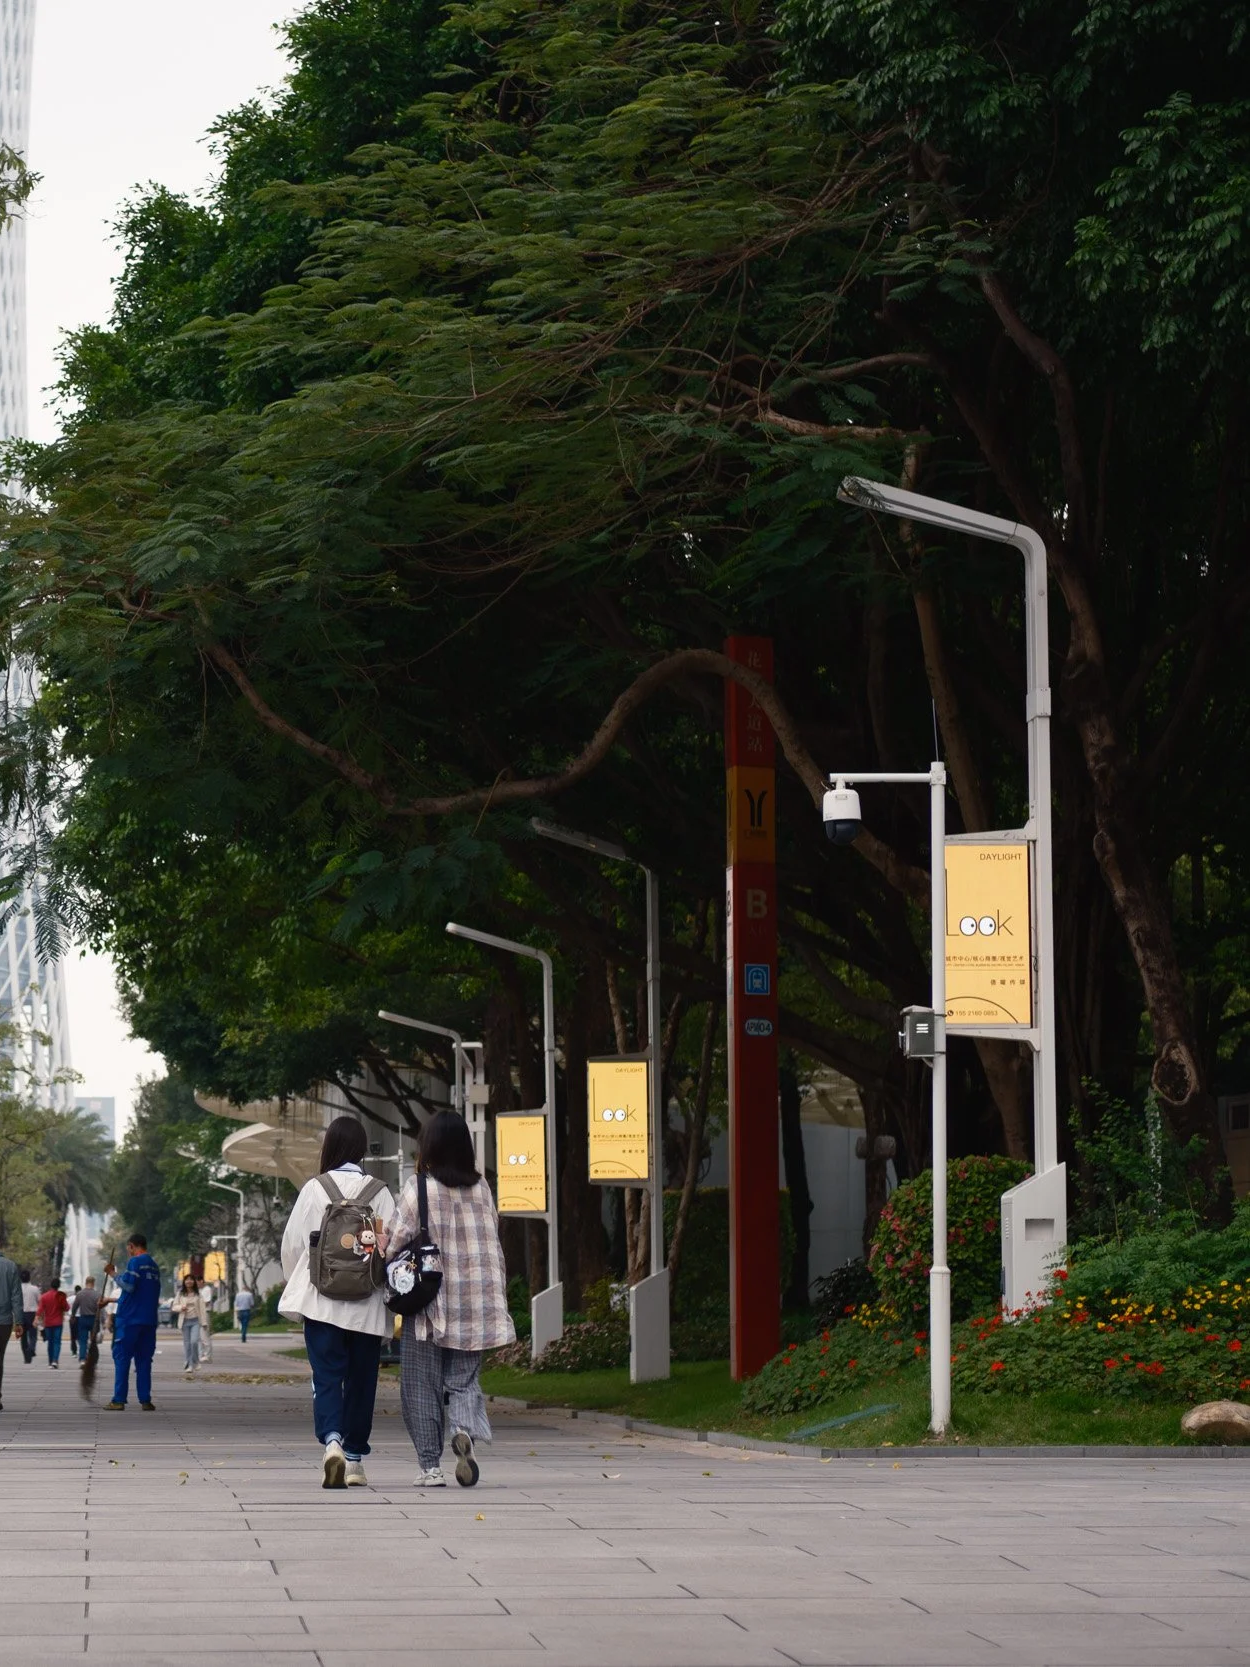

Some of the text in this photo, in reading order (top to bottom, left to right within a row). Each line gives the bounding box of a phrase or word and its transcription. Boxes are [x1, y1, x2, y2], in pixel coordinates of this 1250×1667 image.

[979, 853, 1023, 861] DAYLIGHT
[746, 888, 768, 919] B
[945, 868, 1014, 936] Look
[759, 1022, 771, 1033] 04
[593, 1077, 638, 1122] Look
[500, 1129, 538, 1166] Look
